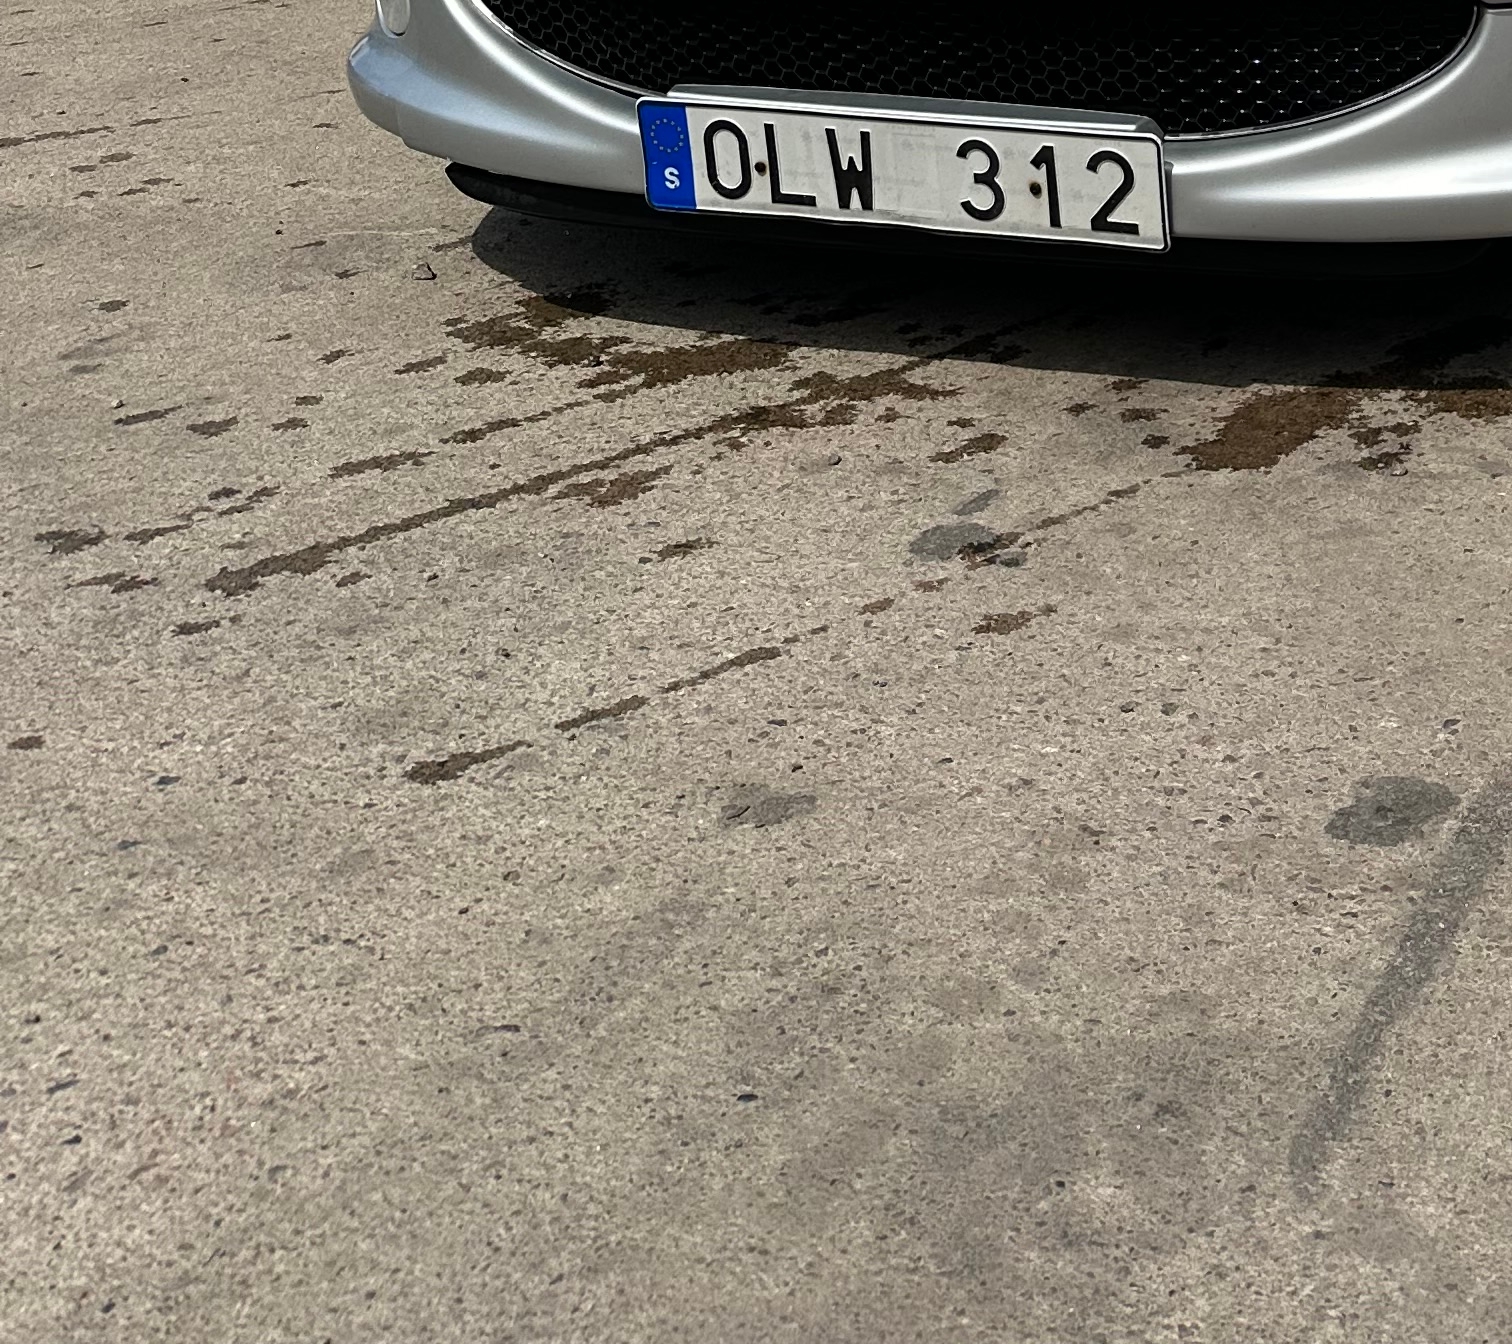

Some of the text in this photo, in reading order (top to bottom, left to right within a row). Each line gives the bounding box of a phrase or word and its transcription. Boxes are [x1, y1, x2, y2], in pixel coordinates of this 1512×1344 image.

[664, 119, 1140, 236] S OLW 312
